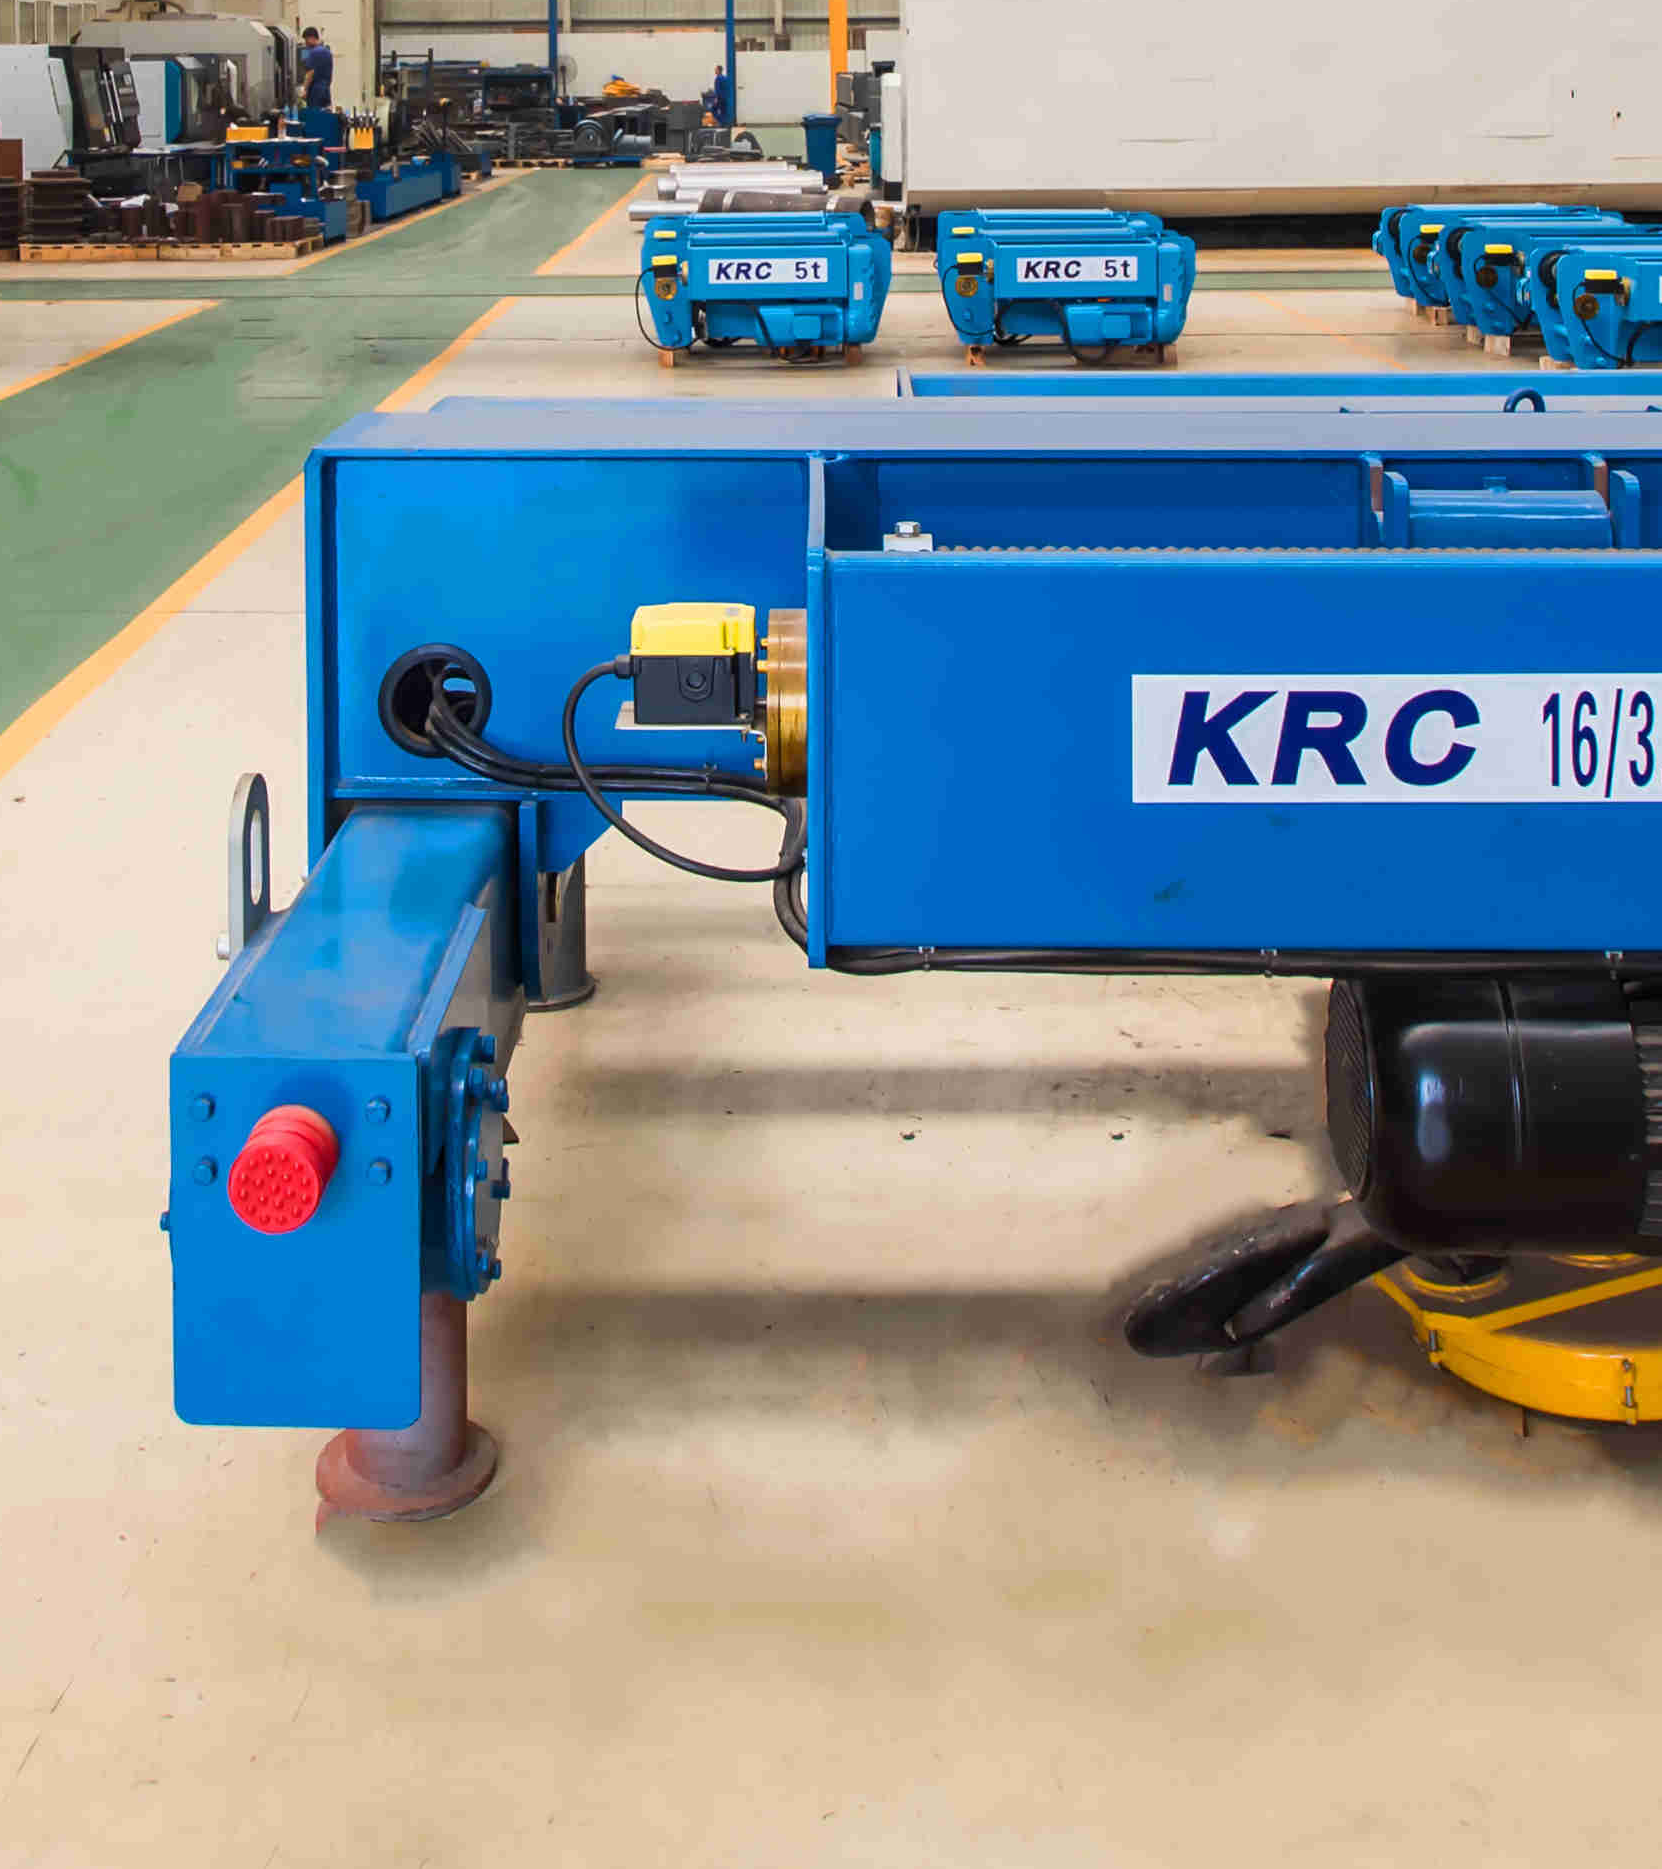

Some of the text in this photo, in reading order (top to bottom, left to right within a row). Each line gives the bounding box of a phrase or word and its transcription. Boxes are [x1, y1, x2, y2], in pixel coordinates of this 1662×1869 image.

[715, 261, 822, 281] KRC 5t
[1023, 259, 1132, 279] KRC 5t
[1167, 689, 1482, 787] KRC
